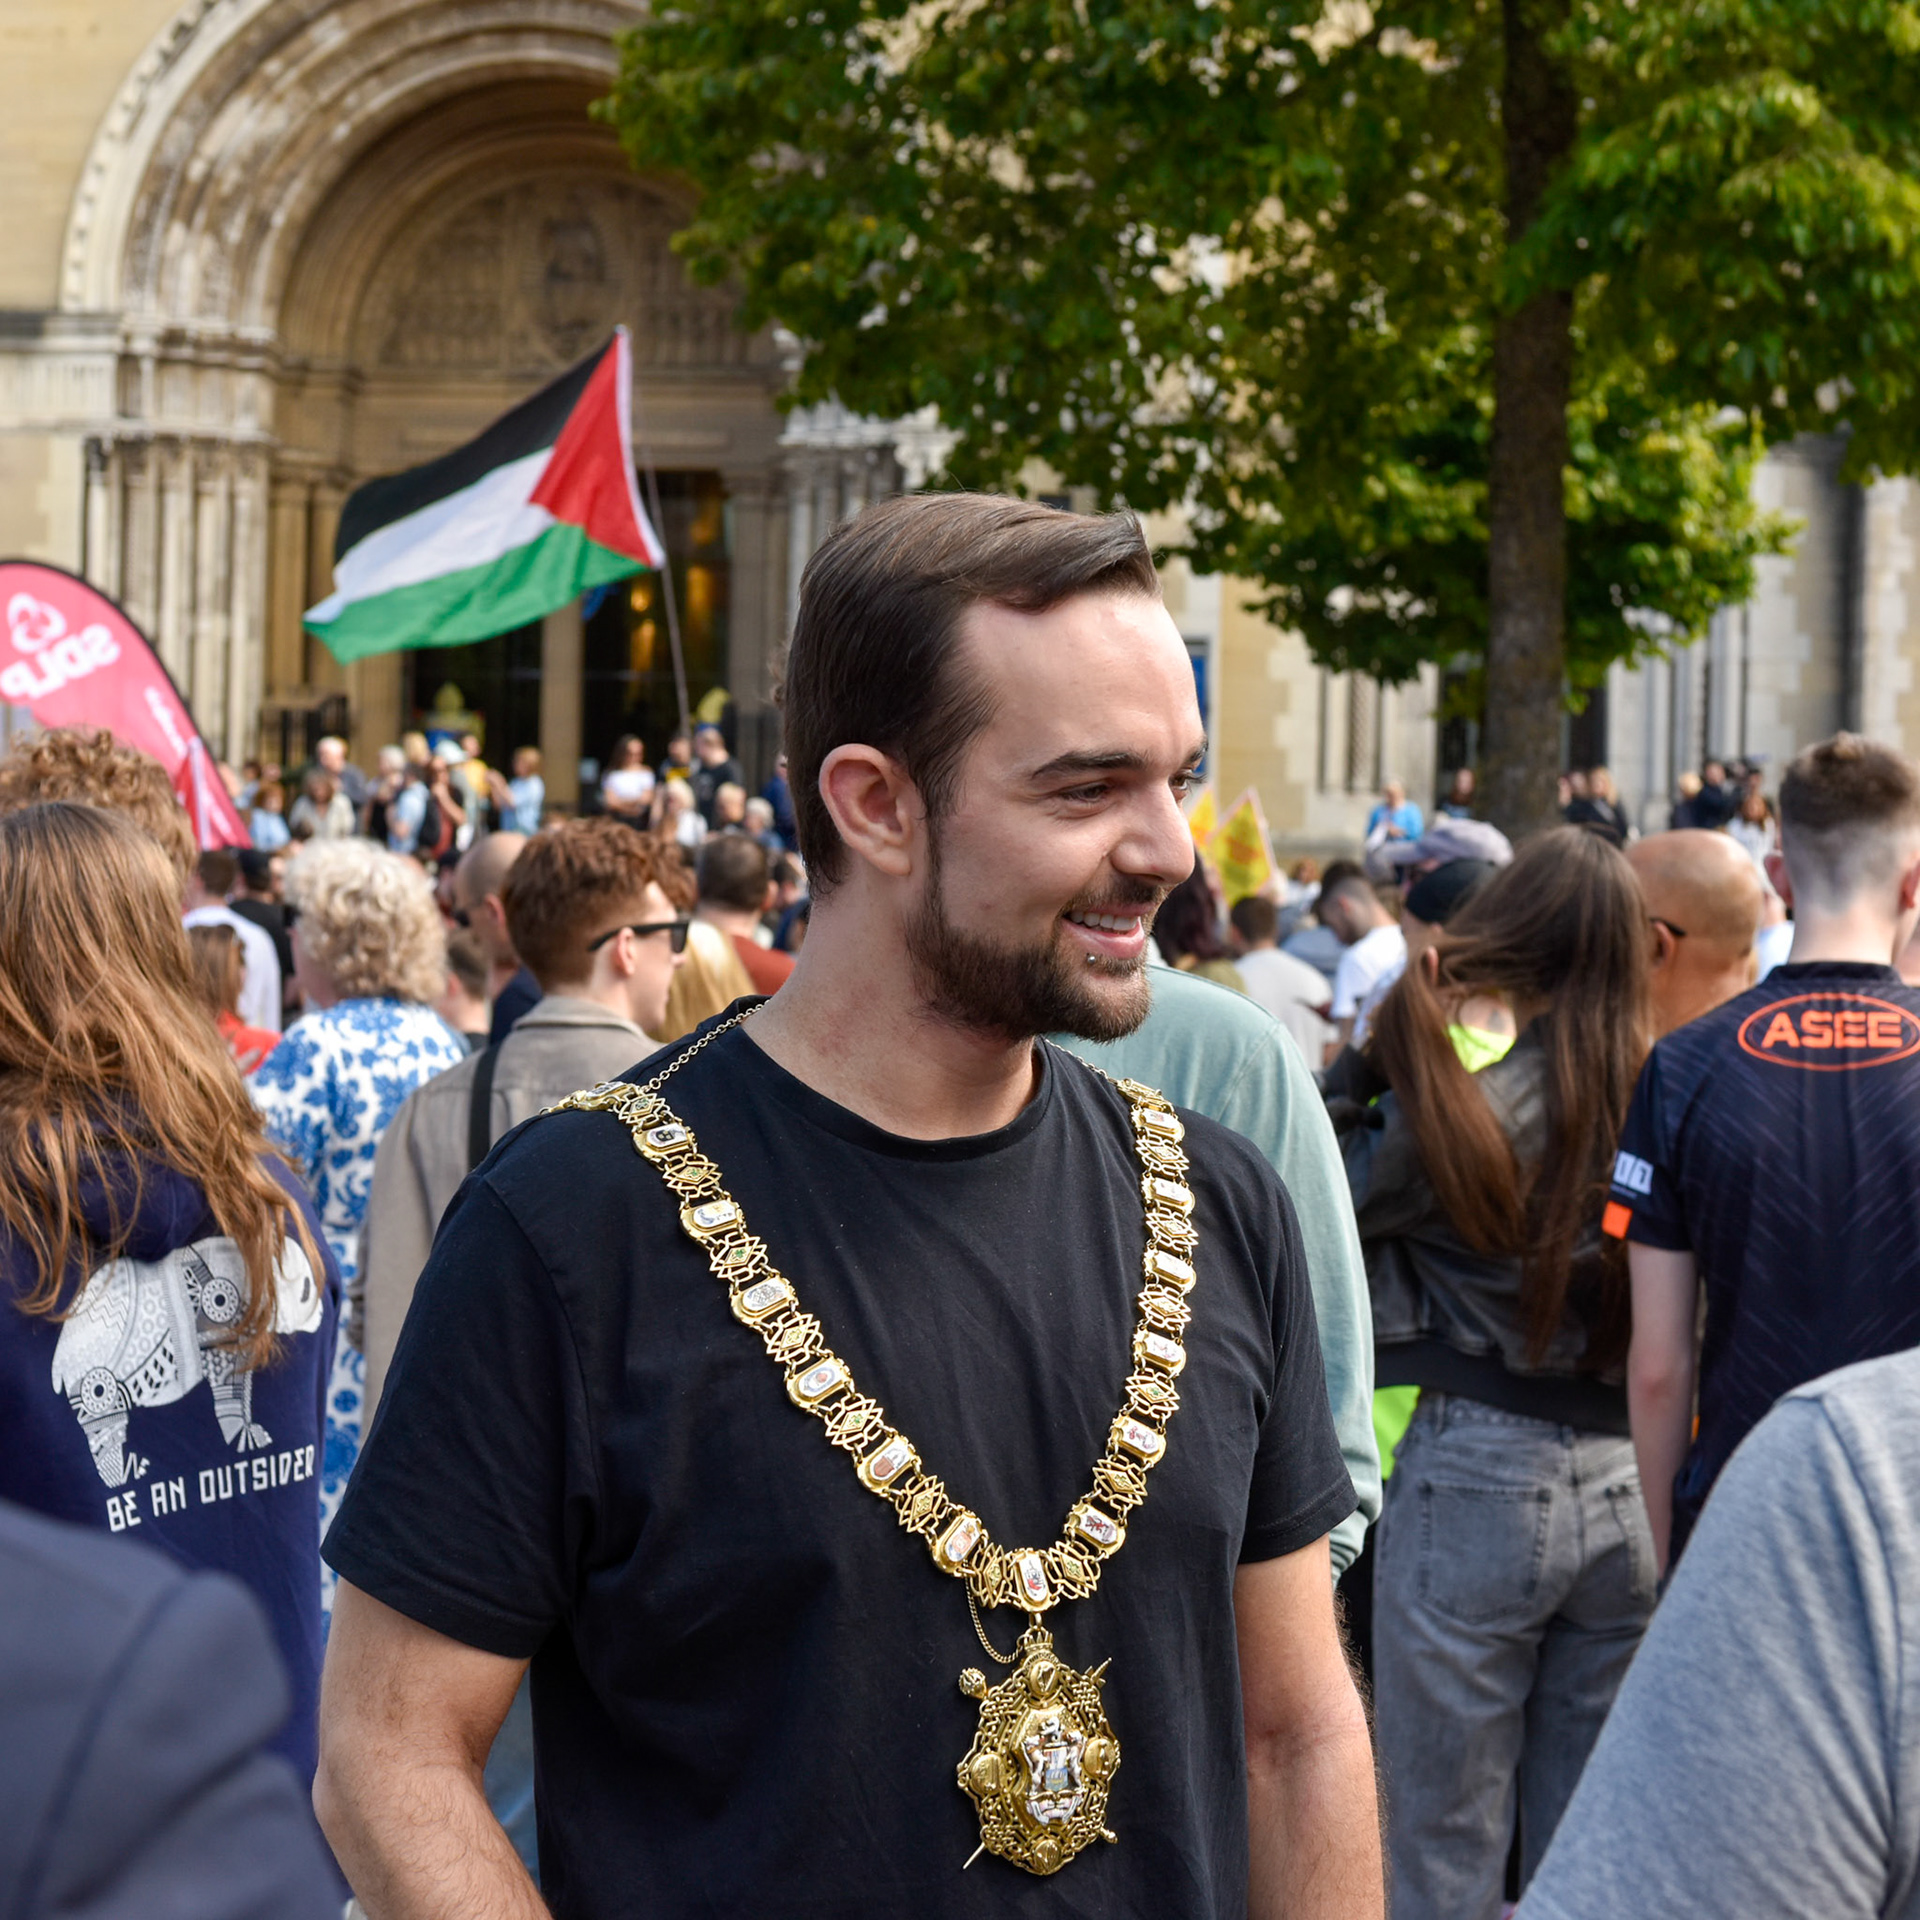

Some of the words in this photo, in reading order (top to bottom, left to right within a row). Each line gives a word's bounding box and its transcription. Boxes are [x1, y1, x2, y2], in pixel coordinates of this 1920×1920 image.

[1761, 1010, 1903, 1049] ASEE
[106, 1490, 141, 1532] BE
[150, 1476, 187, 1517] AN
[199, 1444, 315, 1504] OUTSIDER
